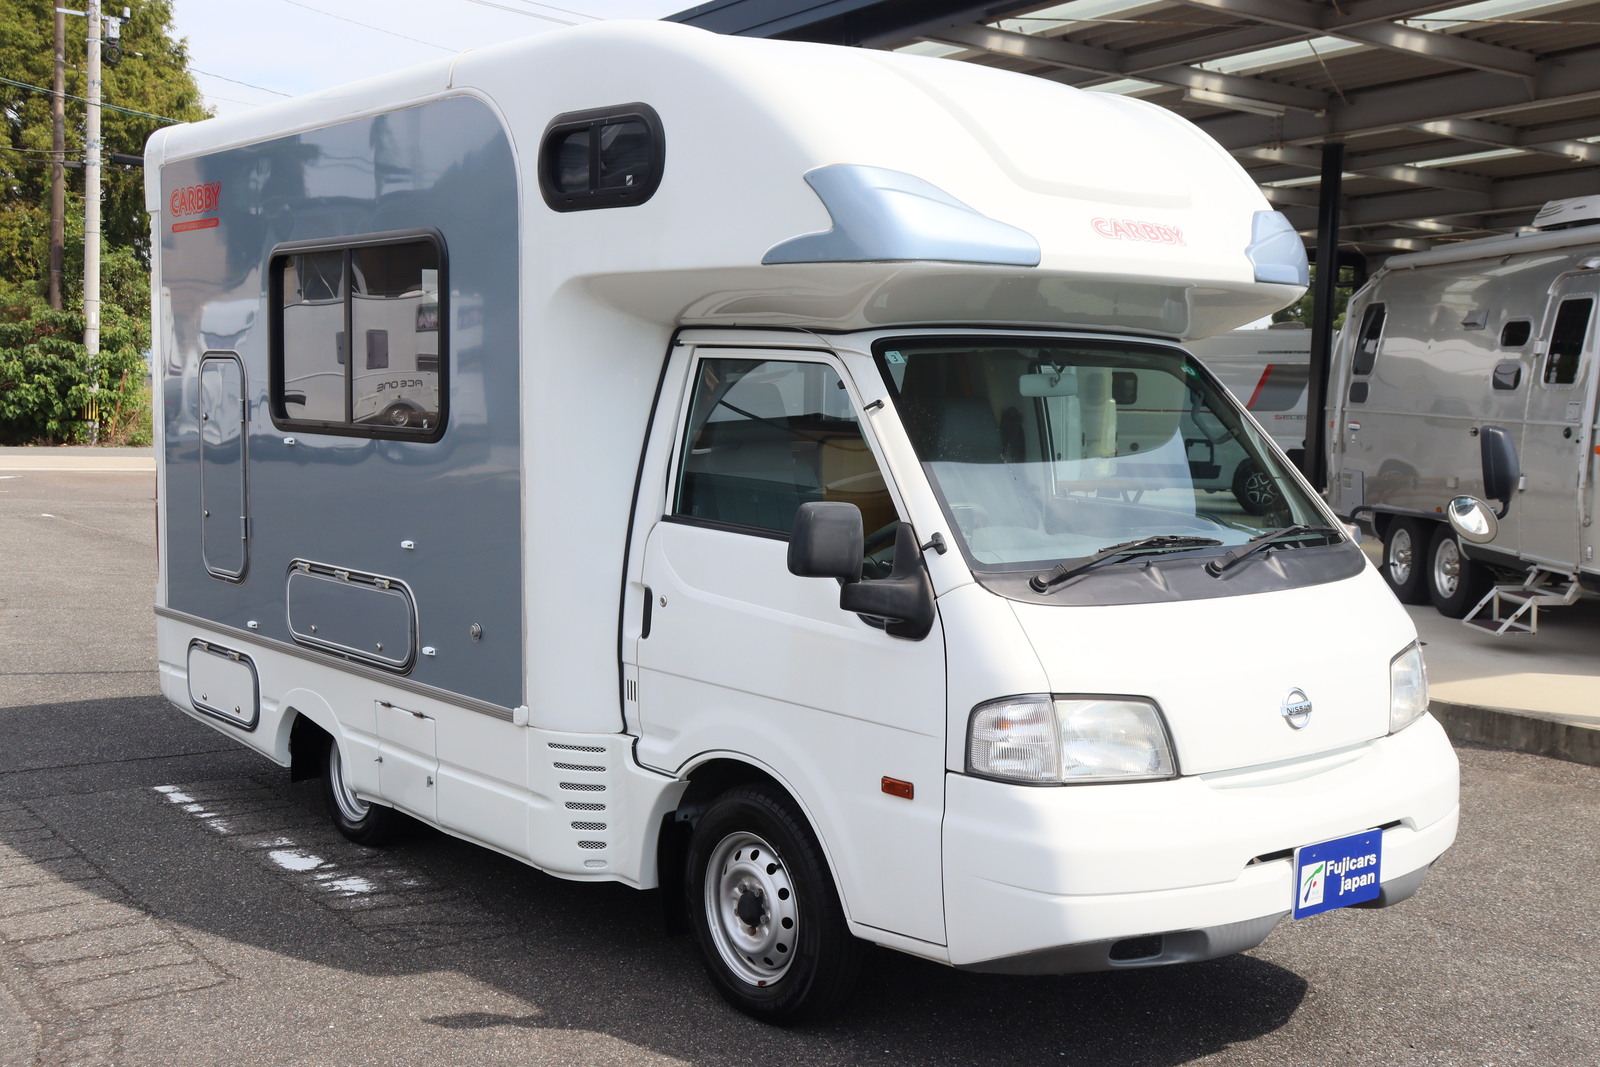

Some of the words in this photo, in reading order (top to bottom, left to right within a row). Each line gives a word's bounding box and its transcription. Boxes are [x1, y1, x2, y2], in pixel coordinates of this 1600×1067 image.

[170, 180, 221, 217] CARBBY
[1091, 217, 1187, 247] CARBBY
[1286, 704, 1312, 715] NISSAN
[1326, 853, 1377, 877] Fujicars
[1339, 872, 1375, 896] japan
